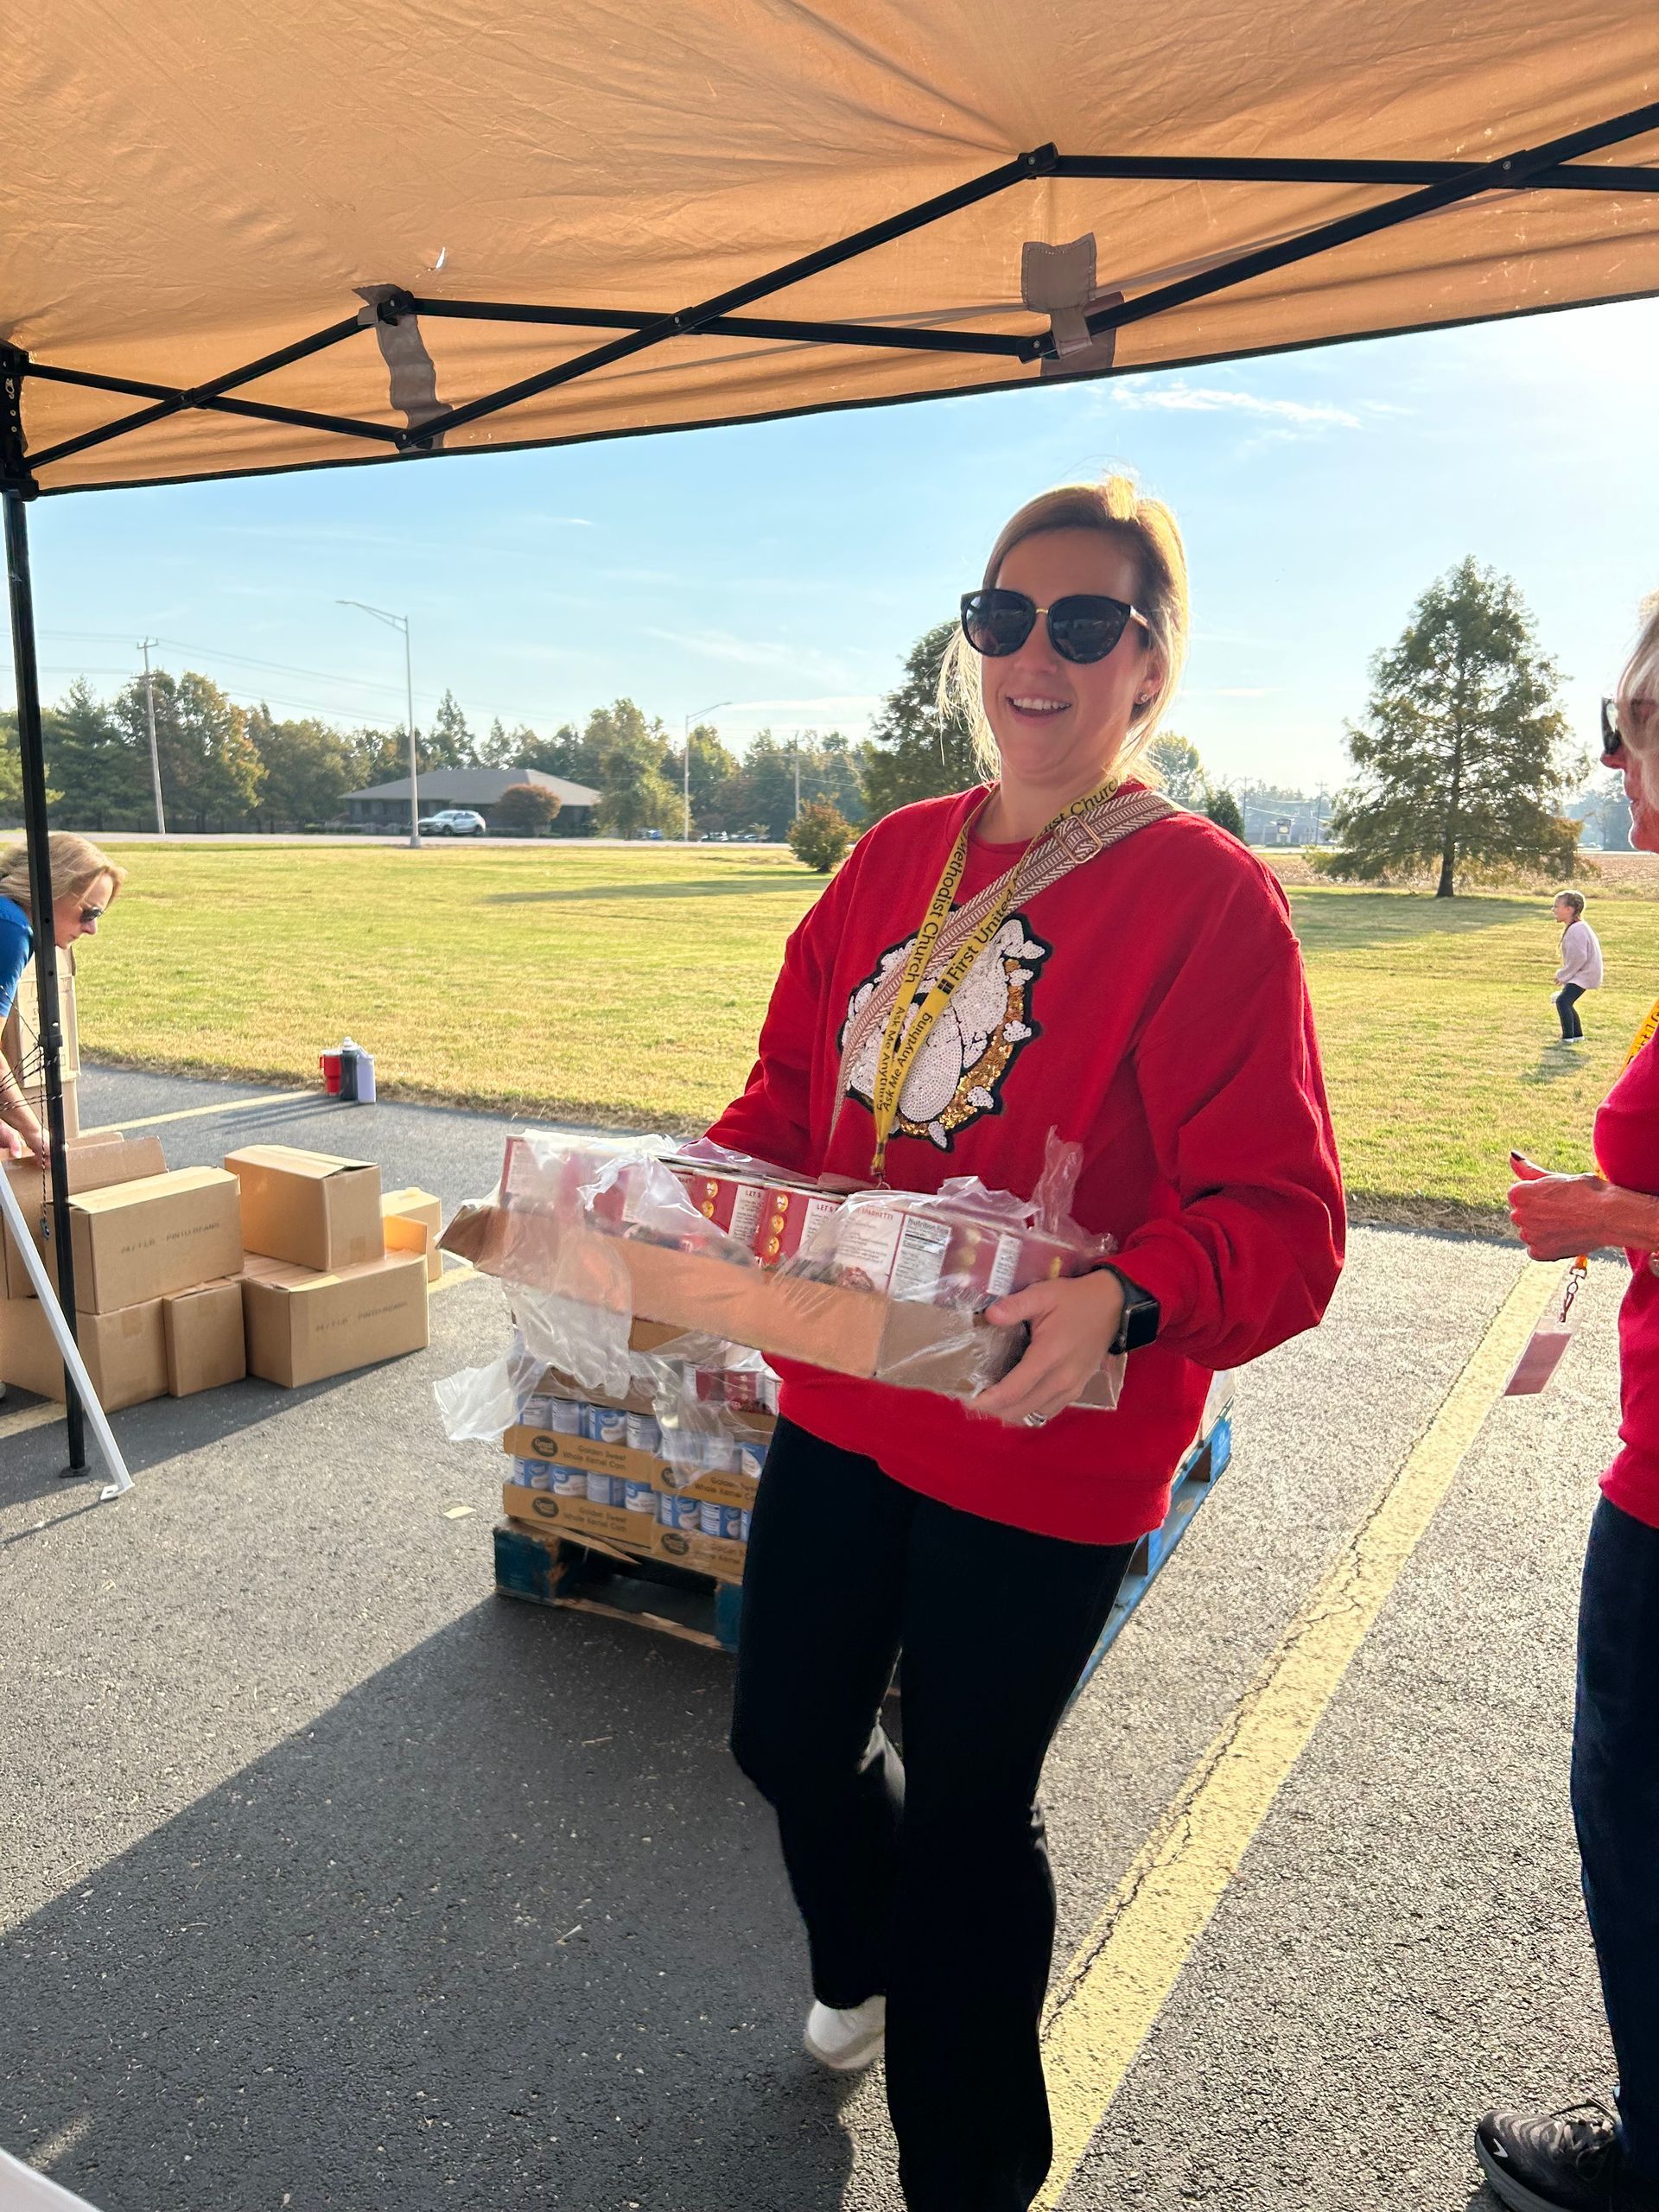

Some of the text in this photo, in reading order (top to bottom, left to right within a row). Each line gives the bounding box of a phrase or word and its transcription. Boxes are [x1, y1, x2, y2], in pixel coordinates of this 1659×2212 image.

[946, 780, 1117, 981] First United Churc
[905, 838, 968, 983] Methodist Church
[892, 1006, 906, 1027] Ask
[886, 1030, 896, 1049] Me
[883, 1012, 933, 1112] Ask Me Anything
[908, 1217, 936, 1230] Nutrition
[563, 1451, 584, 1461] Whole
[609, 1460, 626, 1470] Corn
[578, 1445, 604, 1456] Golden
